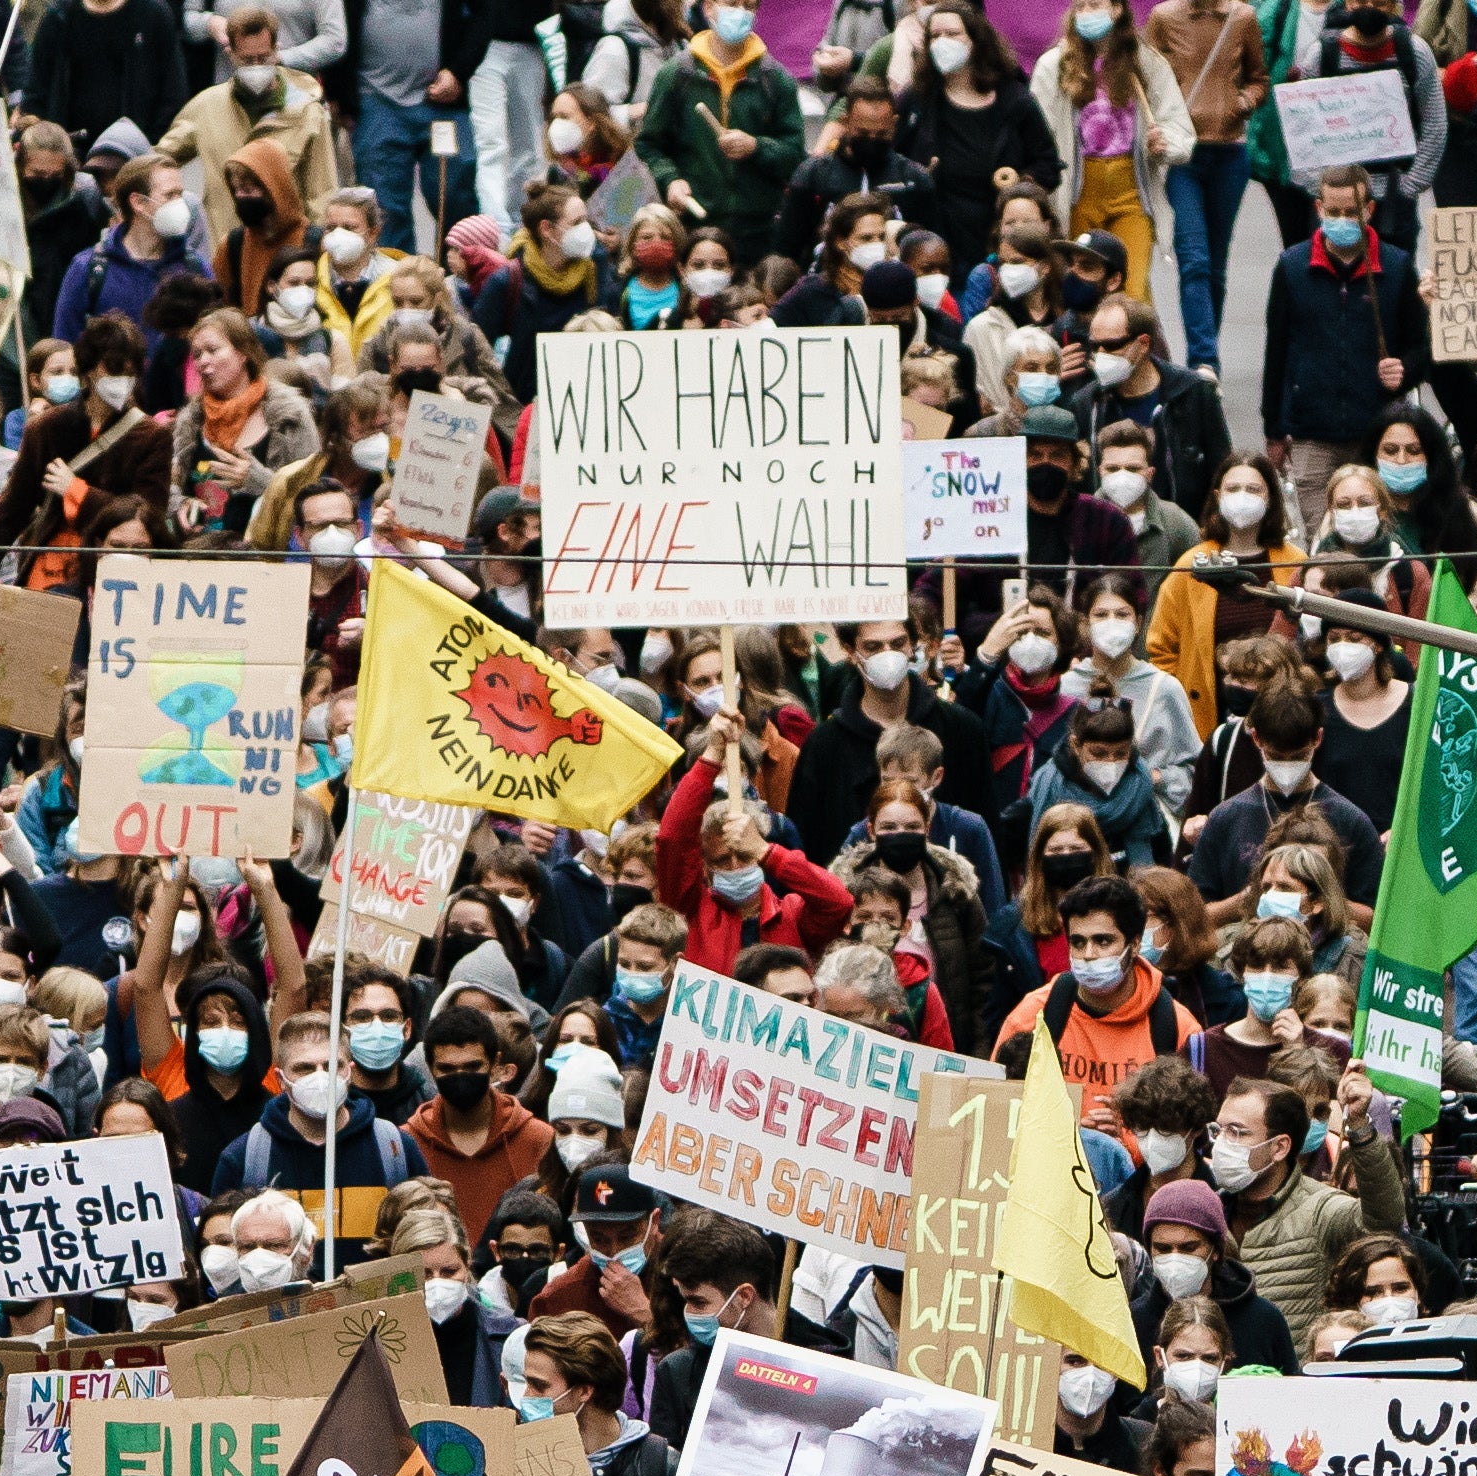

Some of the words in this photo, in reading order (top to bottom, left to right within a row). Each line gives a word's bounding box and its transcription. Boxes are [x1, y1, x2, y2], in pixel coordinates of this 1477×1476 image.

[1440, 303, 1477, 324] NOT
[544, 338, 647, 454] WIR
[674, 336, 884, 450] HABEN
[577, 461, 677, 486] NUR
[722, 459, 876, 485] NOCH
[942, 451, 980, 470] The
[932, 472, 1001, 499] SNOW
[544, 501, 709, 594] EINE
[736, 498, 889, 589] WAHL
[975, 525, 1000, 538] on
[101, 577, 249, 627] TIME
[100, 636, 136, 679] IS
[228, 706, 295, 743] RUN
[426, 711, 486, 792] NEIN
[494, 753, 578, 803] DANKE
[238, 775, 284, 797] NG
[114, 802, 239, 857] OUT
[1372, 966, 1399, 1004] Wir
[658, 1041, 918, 1177] UMSETZEN
[636, 1111, 763, 1213] ABER
[30, 1371, 172, 1403] NIEMAND
[738, 1359, 799, 1388] DATTELN
[802, 1376, 813, 1392] 4
